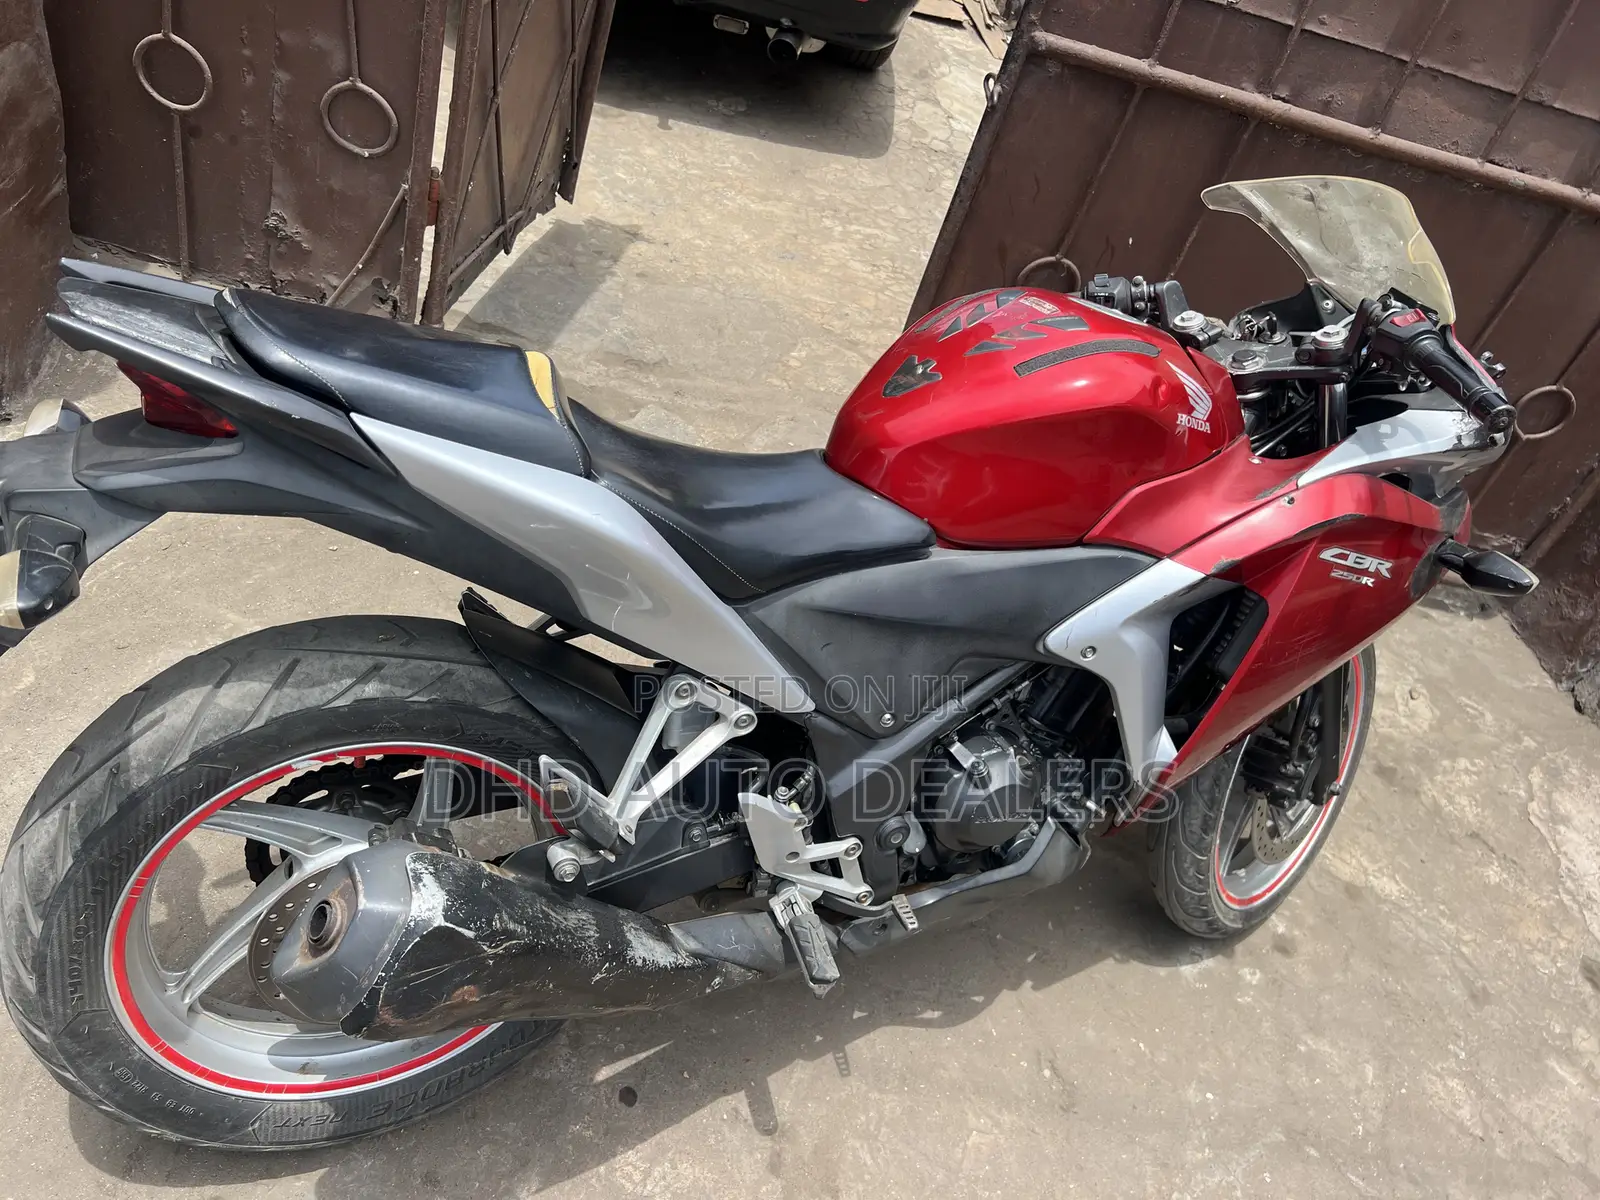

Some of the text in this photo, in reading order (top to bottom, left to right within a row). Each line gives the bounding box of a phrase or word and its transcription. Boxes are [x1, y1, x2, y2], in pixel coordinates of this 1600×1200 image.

[1176, 413, 1211, 433] HONDA
[1318, 546, 1393, 578] CBR
[1330, 569, 1375, 587] 250R
